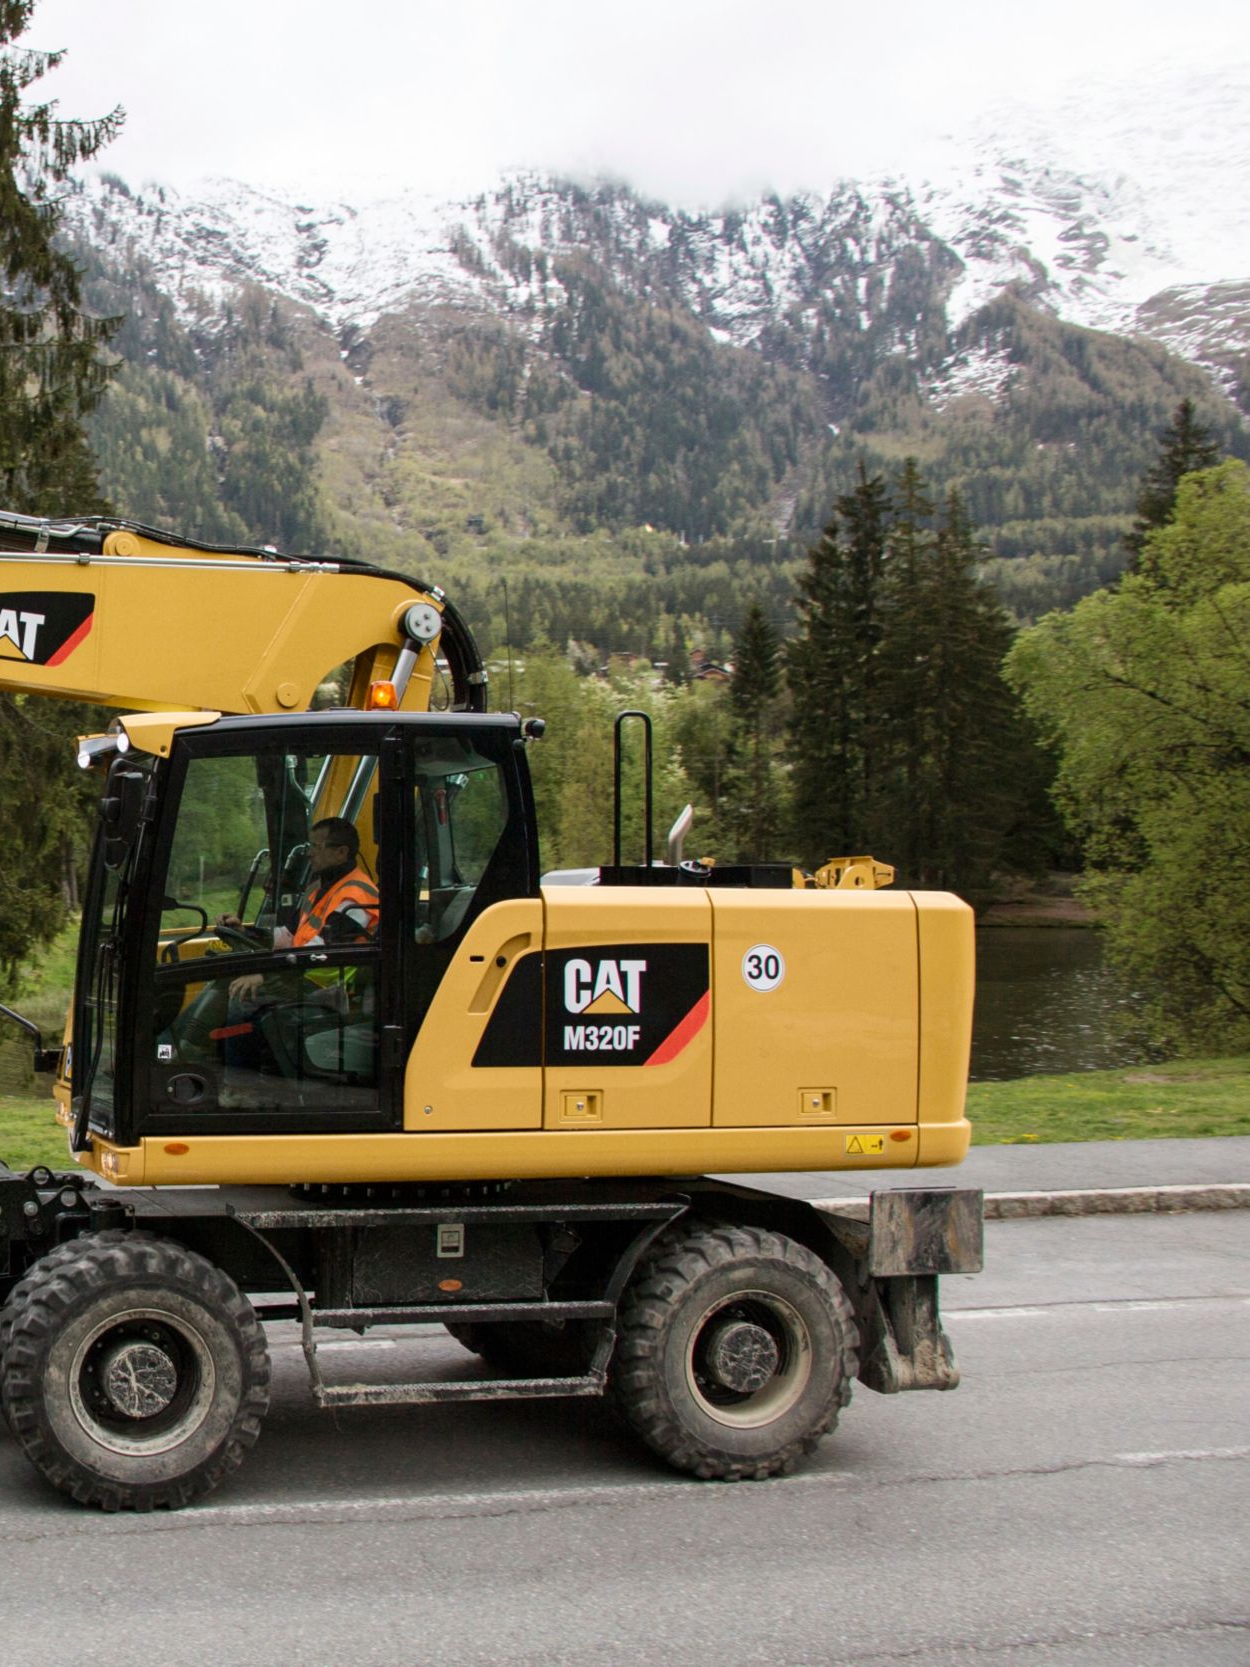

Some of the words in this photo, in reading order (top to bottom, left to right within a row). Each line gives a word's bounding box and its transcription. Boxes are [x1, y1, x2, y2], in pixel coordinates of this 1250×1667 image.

[747, 954, 780, 980] 30
[564, 958, 647, 1015] CAT
[563, 1025, 641, 1051] M320F
